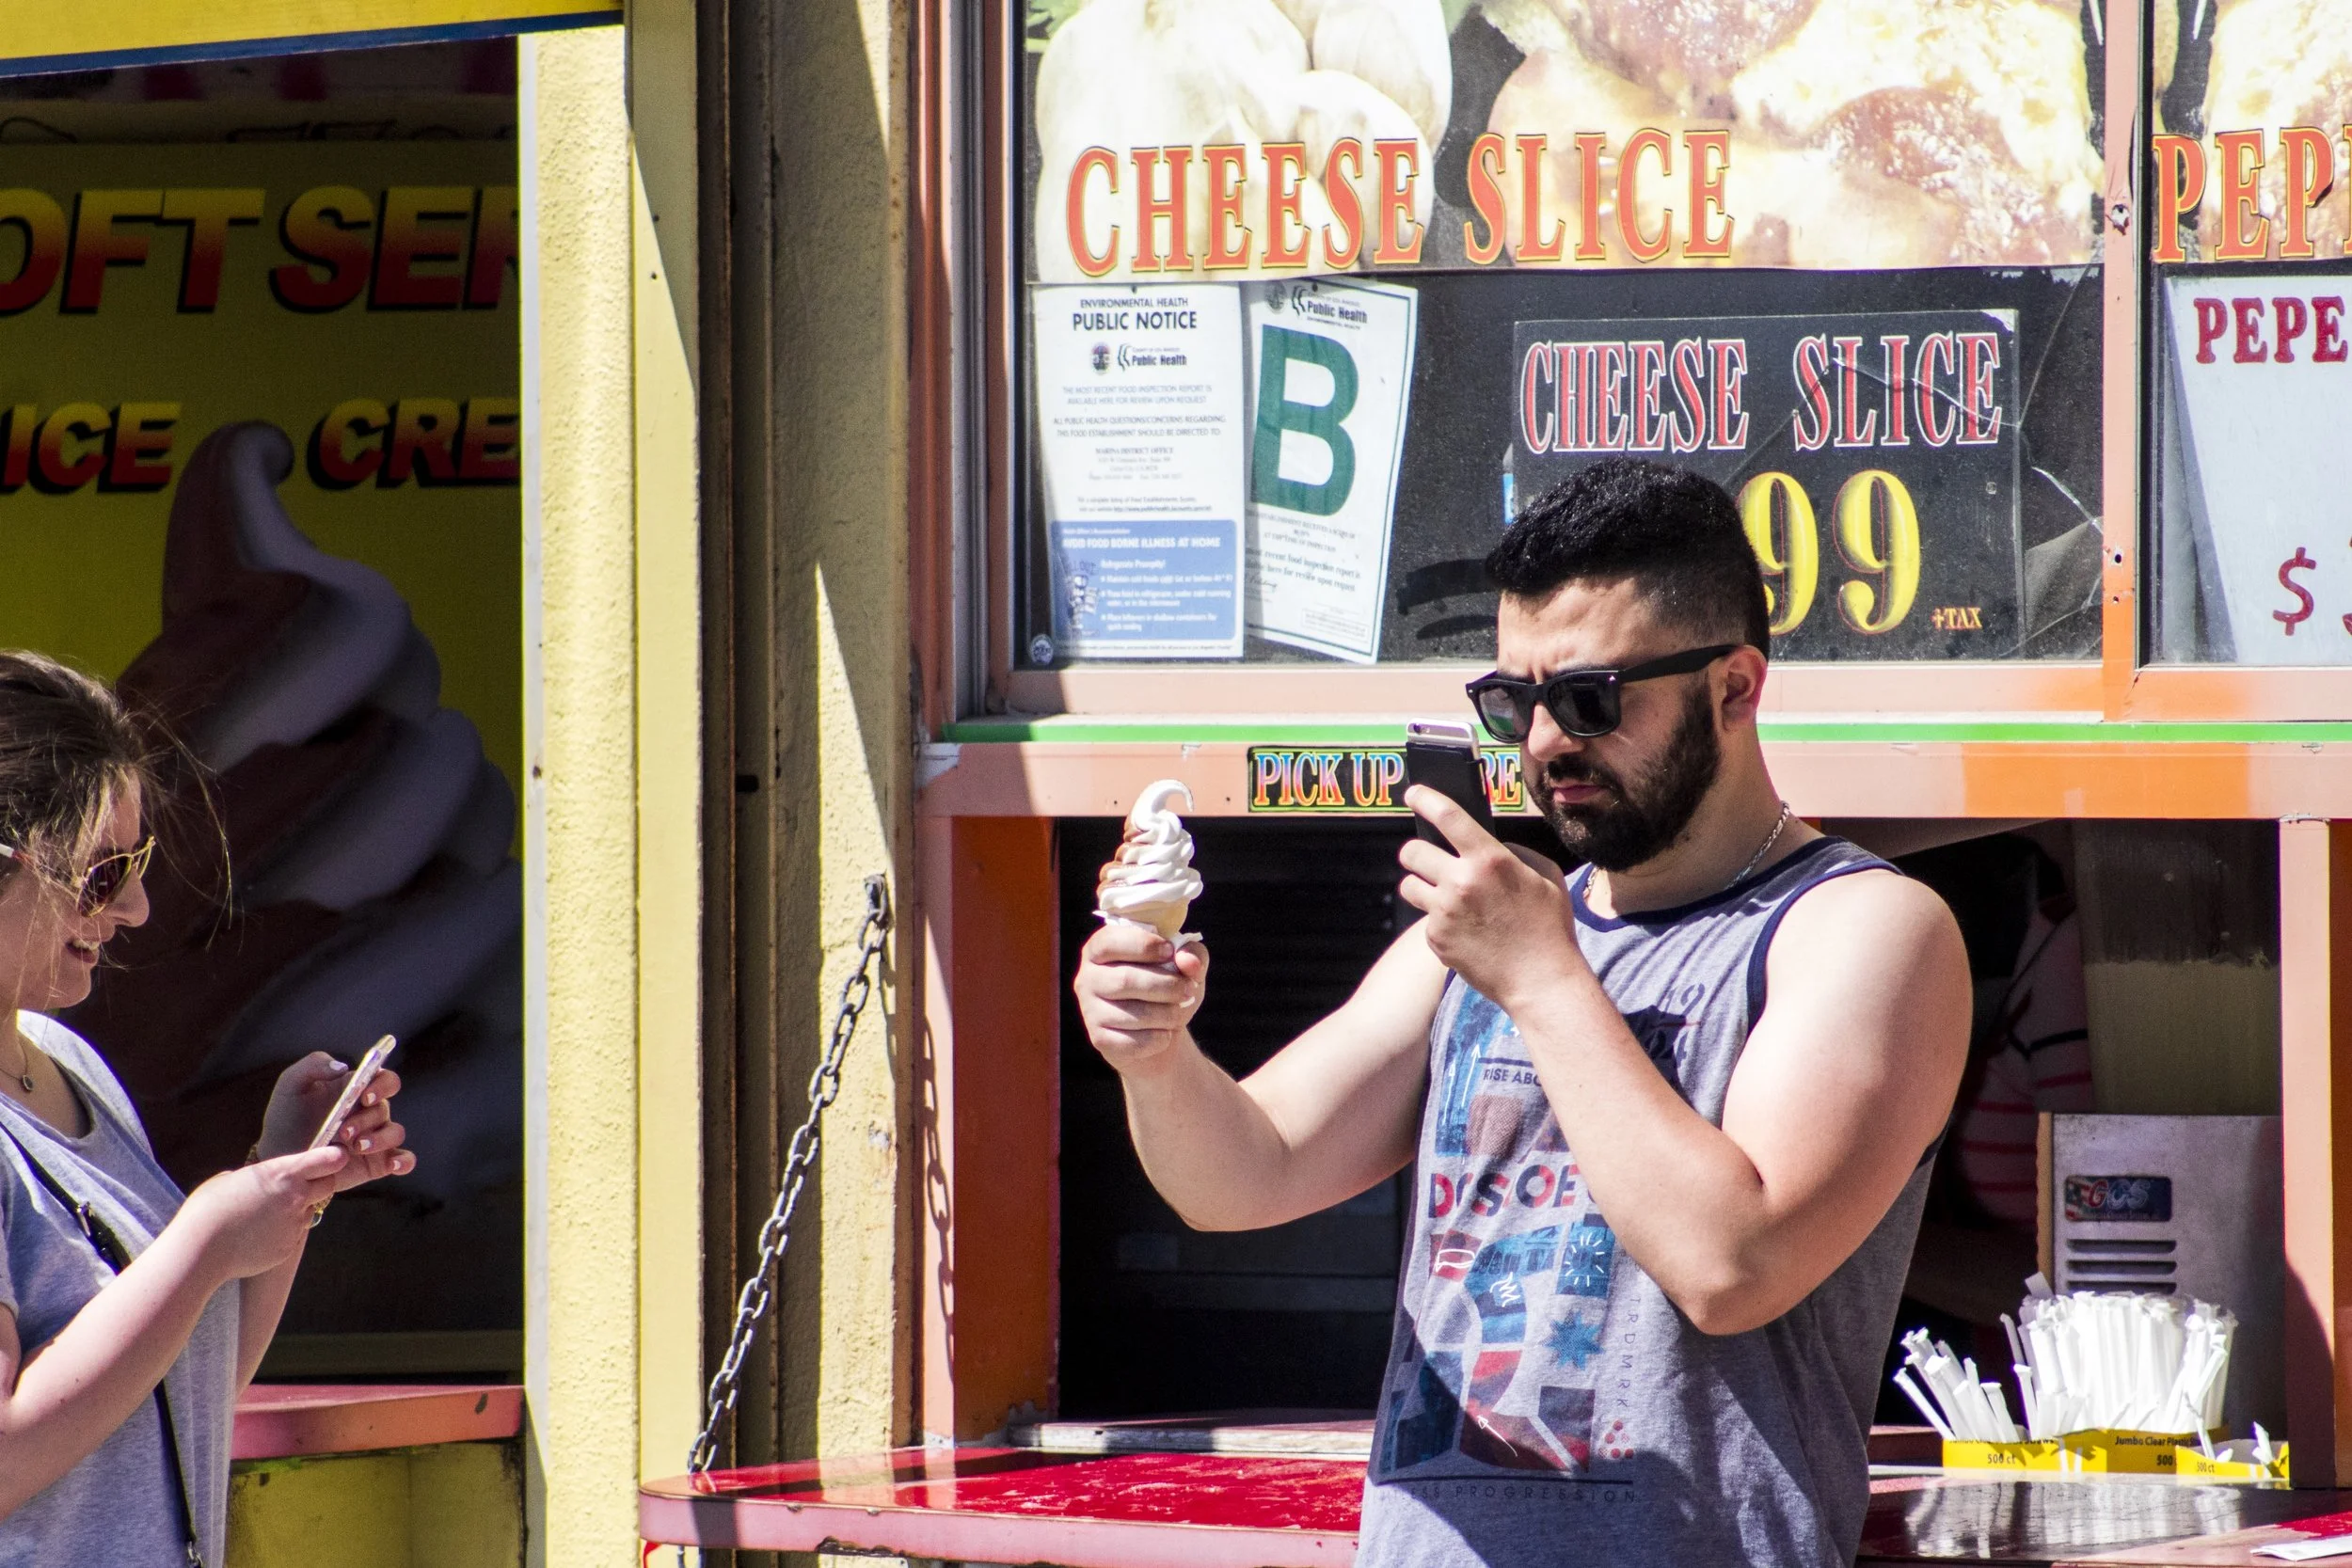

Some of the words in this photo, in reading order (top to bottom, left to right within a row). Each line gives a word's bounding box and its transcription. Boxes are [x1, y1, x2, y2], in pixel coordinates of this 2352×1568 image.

[1066, 135, 1425, 277] CHEESE
[1464, 127, 1735, 267] SLICE
[1080, 298, 1153, 309] ENVIRONMENTAL
[1157, 297, 1188, 308] HEALTH
[1308, 300, 1335, 317] Public
[1339, 307, 1368, 324] Health
[1073, 312, 1129, 330] PUBLIC
[1136, 311, 1198, 329] NOTICE
[2194, 295, 2348, 364] PEPE
[1132, 355, 1157, 366] Public
[1160, 355, 1187, 366] Health
[1520, 338, 1750, 454] CHEESE
[1792, 331, 2003, 451] SLICE
[1252, 324, 1359, 516] B
[0, 402, 182, 494] ICE
[1087, 539, 1110, 548] FOOD
[1141, 538, 1175, 547] ILLNESS
[1178, 537, 1189, 547] AT
[1192, 537, 1221, 547] HOME
[1736, 470, 1920, 635] 99
[1931, 607, 1983, 631] +TAX
[1254, 752, 1345, 806] PICK
[1350, 752, 1406, 806] UP
[1483, 1068, 1509, 1081] RISE
[2115, 1435, 2144, 1445] Jumbo
[2145, 1435, 2167, 1446] Clear
[1987, 1453, 2004, 1465] 500
[2156, 1454, 2173, 1466] 500
[1455, 1485, 1636, 1503] PROGRESSION
